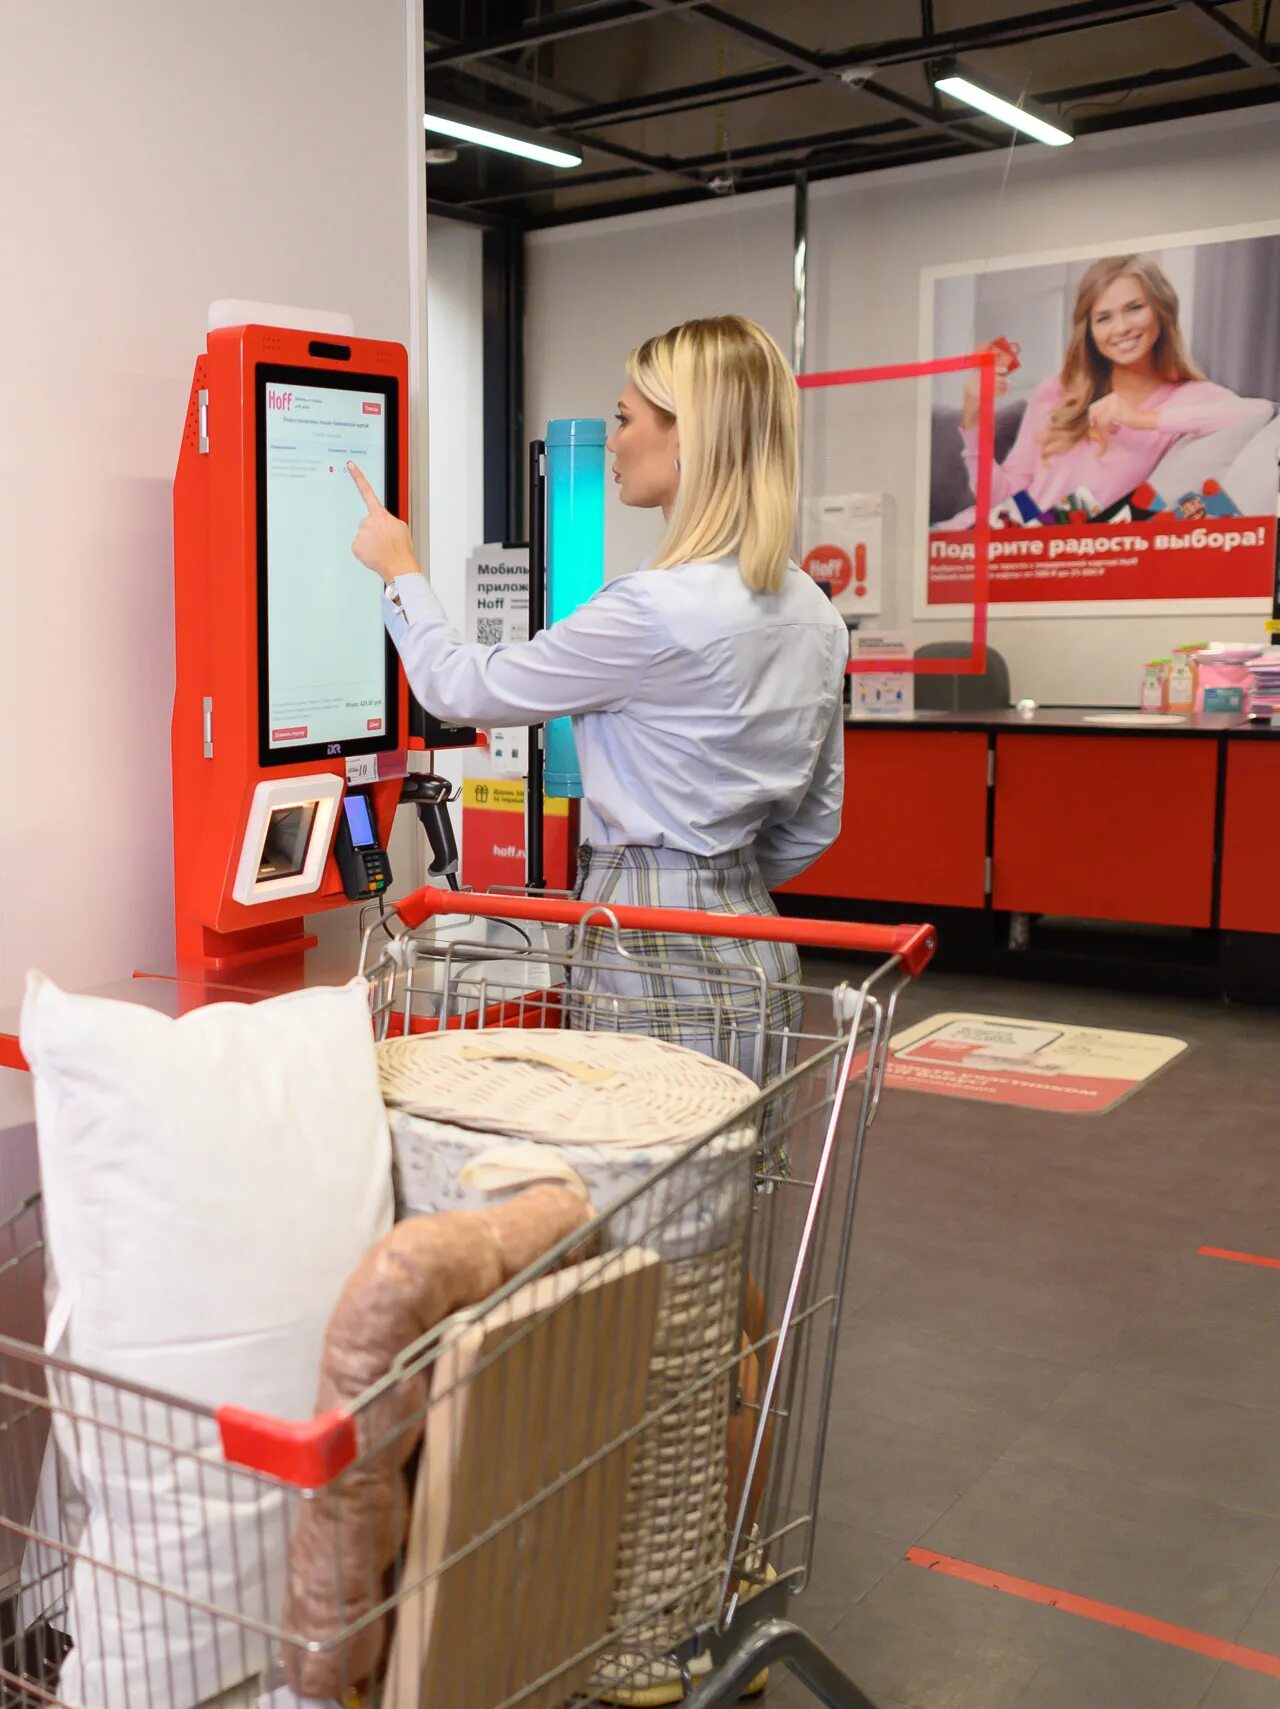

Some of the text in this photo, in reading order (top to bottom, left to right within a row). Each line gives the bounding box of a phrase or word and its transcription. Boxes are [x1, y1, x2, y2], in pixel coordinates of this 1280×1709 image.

[268, 389, 293, 411] Hoff
[930, 527, 1266, 560] Подрите радость выбора!
[477, 563, 529, 575] Мобиль
[477, 582, 528, 595] прилож
[477, 598, 504, 609] Hoff
[492, 844, 526, 859] hoff.r
